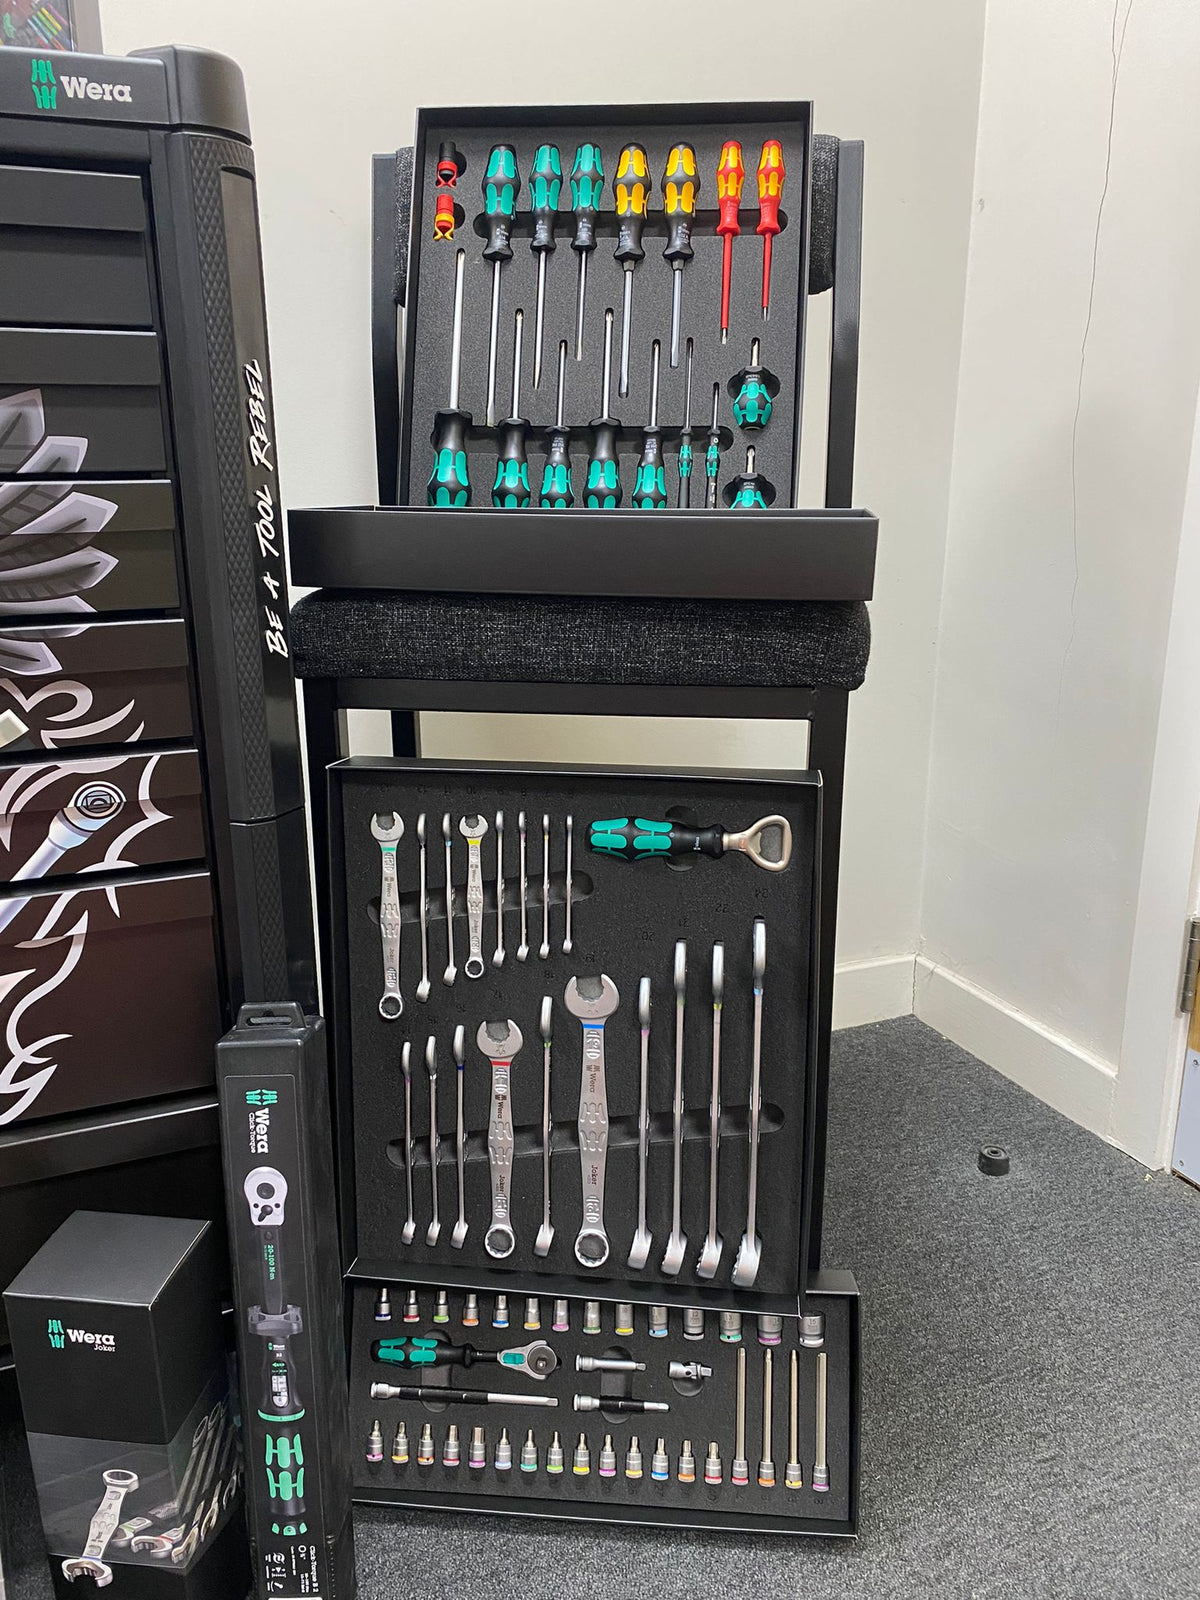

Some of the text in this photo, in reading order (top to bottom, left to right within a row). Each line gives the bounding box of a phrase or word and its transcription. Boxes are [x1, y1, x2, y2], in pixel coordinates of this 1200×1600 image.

[60, 76, 132, 102] Wera
[246, 360, 288, 658] BE A TOOL REBEL
[255, 1107, 270, 1154] Wera
[66, 1328, 116, 1346] Wera
[94, 1344, 116, 1352] Joker
